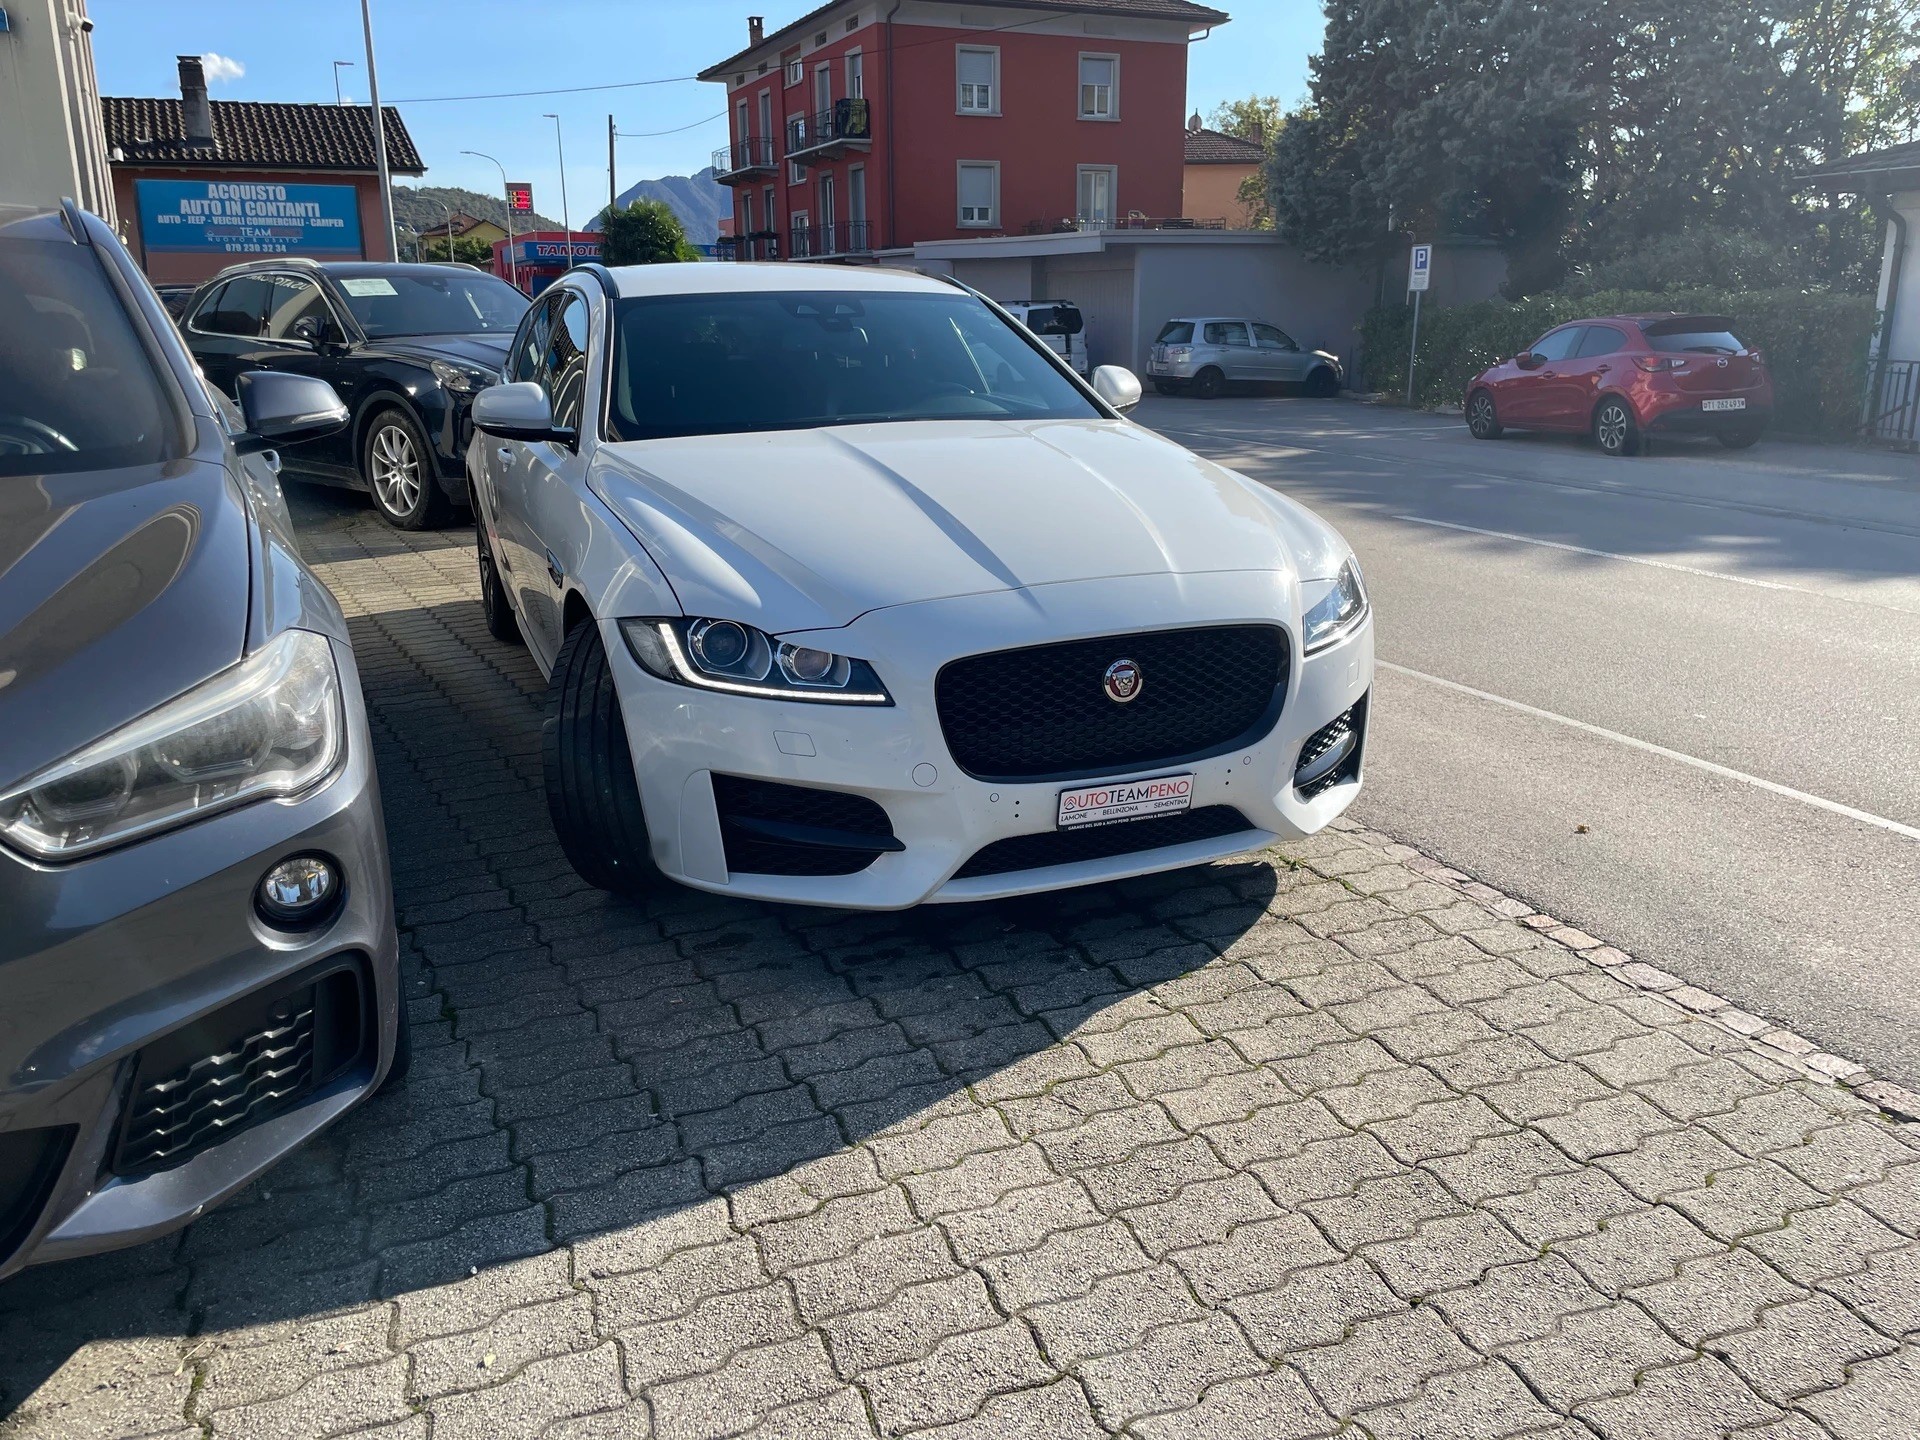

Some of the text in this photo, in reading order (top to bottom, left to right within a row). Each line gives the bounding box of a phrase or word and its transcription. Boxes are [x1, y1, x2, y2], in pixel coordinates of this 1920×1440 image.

[208, 184, 286, 200] ACQUISTO
[180, 200, 321, 217] AUTO IN CONTANTI
[157, 215, 181, 224] AUTO
[187, 215, 206, 224] JEEP
[212, 216, 245, 225] VEICOLI
[246, 217, 305, 226] COMMERCIALI
[310, 218, 344, 227] CAMPER
[240, 227, 271, 236] TEAM
[243, 244, 260, 252] 230
[262, 244, 274, 252] 32
[275, 244, 287, 252] 34
[1416, 250, 1426, 268] P
[1061, 798, 1188, 821] LAMONE BELLINZONA SEMENTINA
